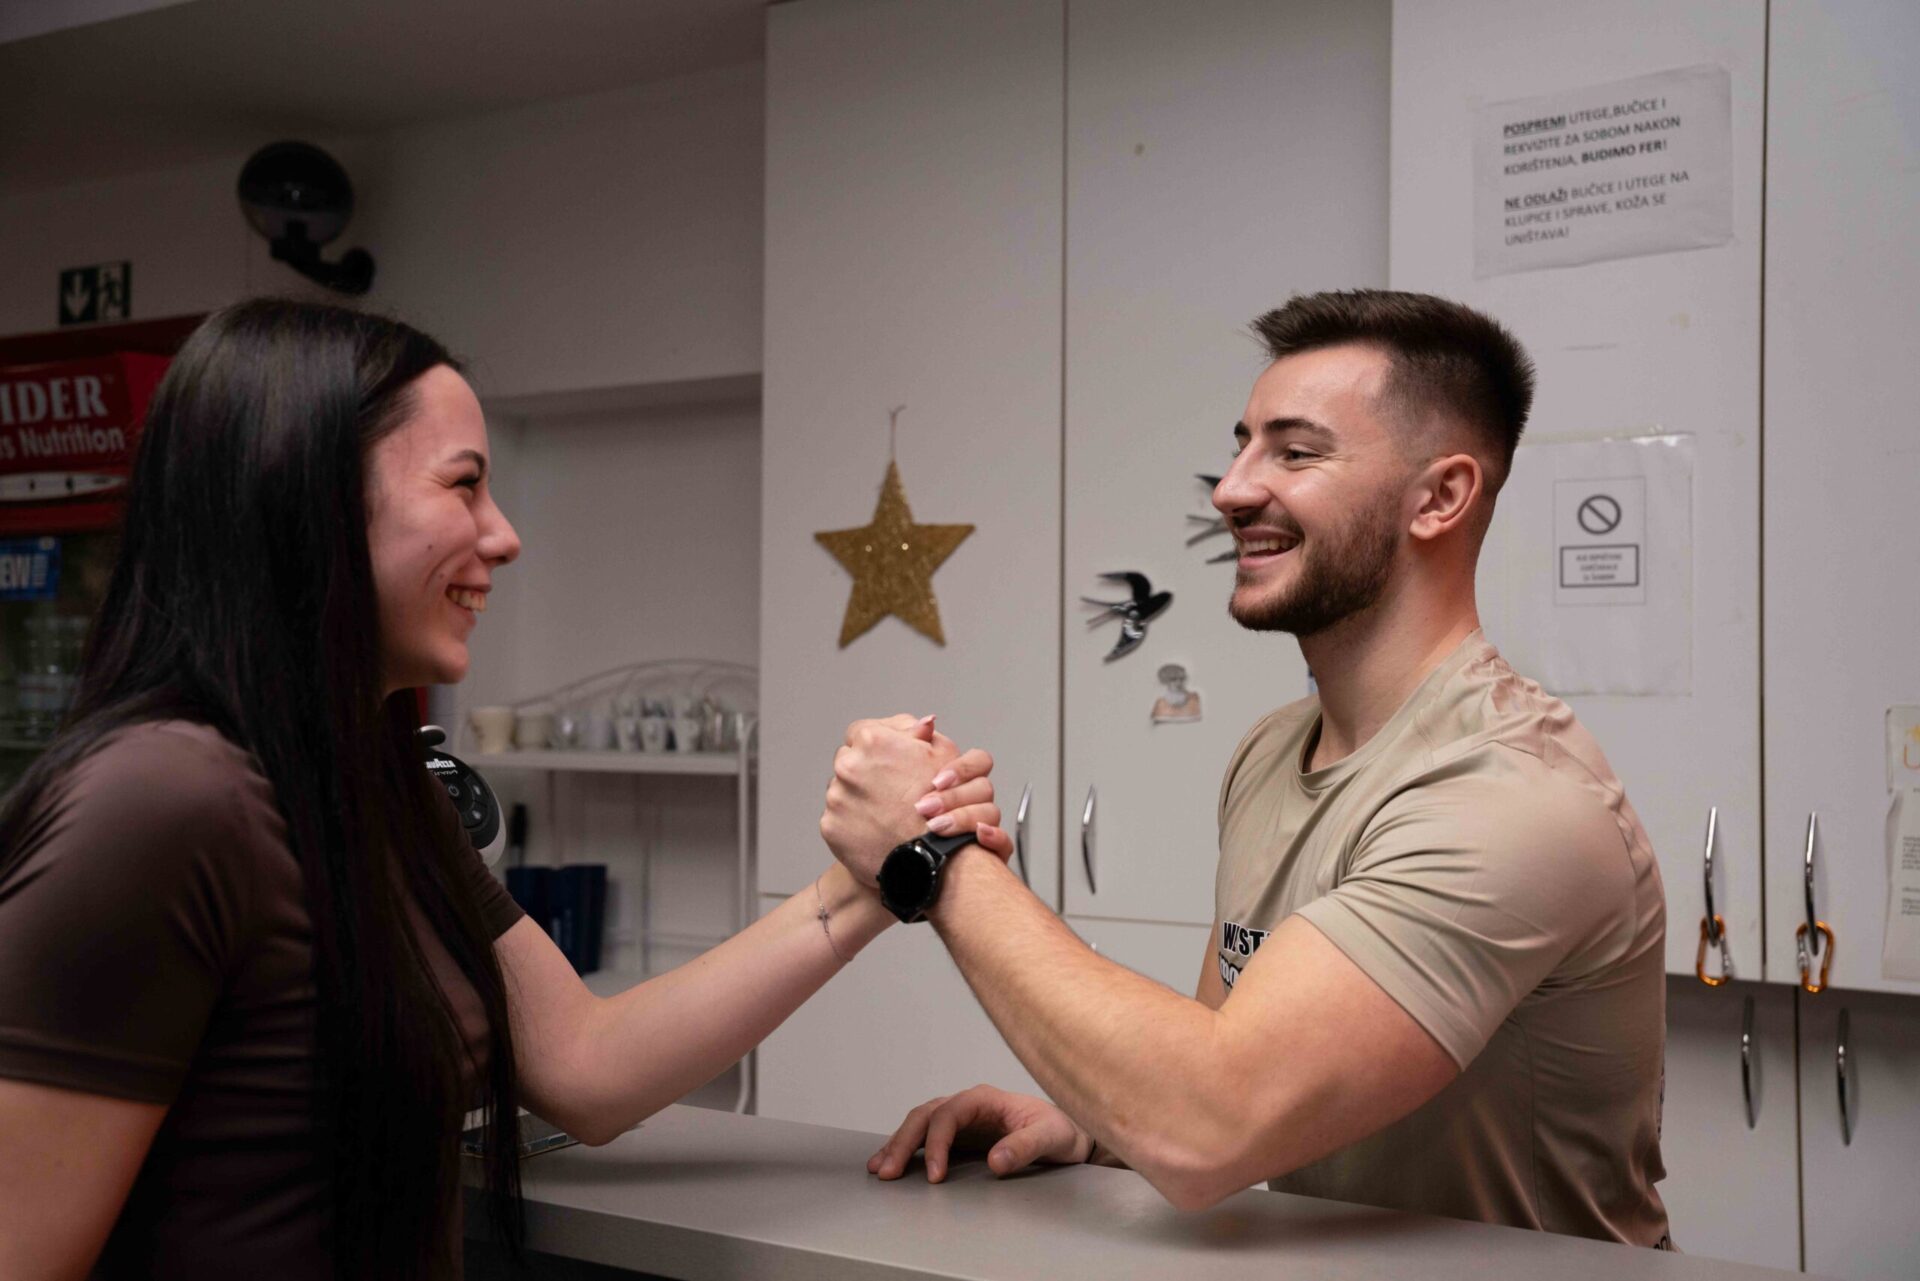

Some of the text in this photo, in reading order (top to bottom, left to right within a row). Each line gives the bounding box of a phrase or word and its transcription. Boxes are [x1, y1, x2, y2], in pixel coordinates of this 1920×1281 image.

[1503, 114, 1566, 138] POSPREMI
[1504, 115, 1680, 156] REKVIZITE ZA SOBOM NAKON
[1581, 144, 1636, 164] BUDIMO
[1638, 138, 1668, 154] FER!
[1504, 196, 1520, 210] NE
[1523, 186, 1568, 208] ODLAŽI
[1571, 182, 1614, 199] BUČICE
[1625, 174, 1665, 191] UTEGE
[1669, 170, 1690, 184] NA
[1504, 210, 1552, 227] KLUPICE
[1562, 201, 1612, 220] SPRAVE,
[1615, 192, 1650, 210] KOŽA
[1652, 191, 1667, 207] SE
[1504, 226, 1569, 246] UNIŠTAVA!
[18, 422, 125, 459] Nutrition
